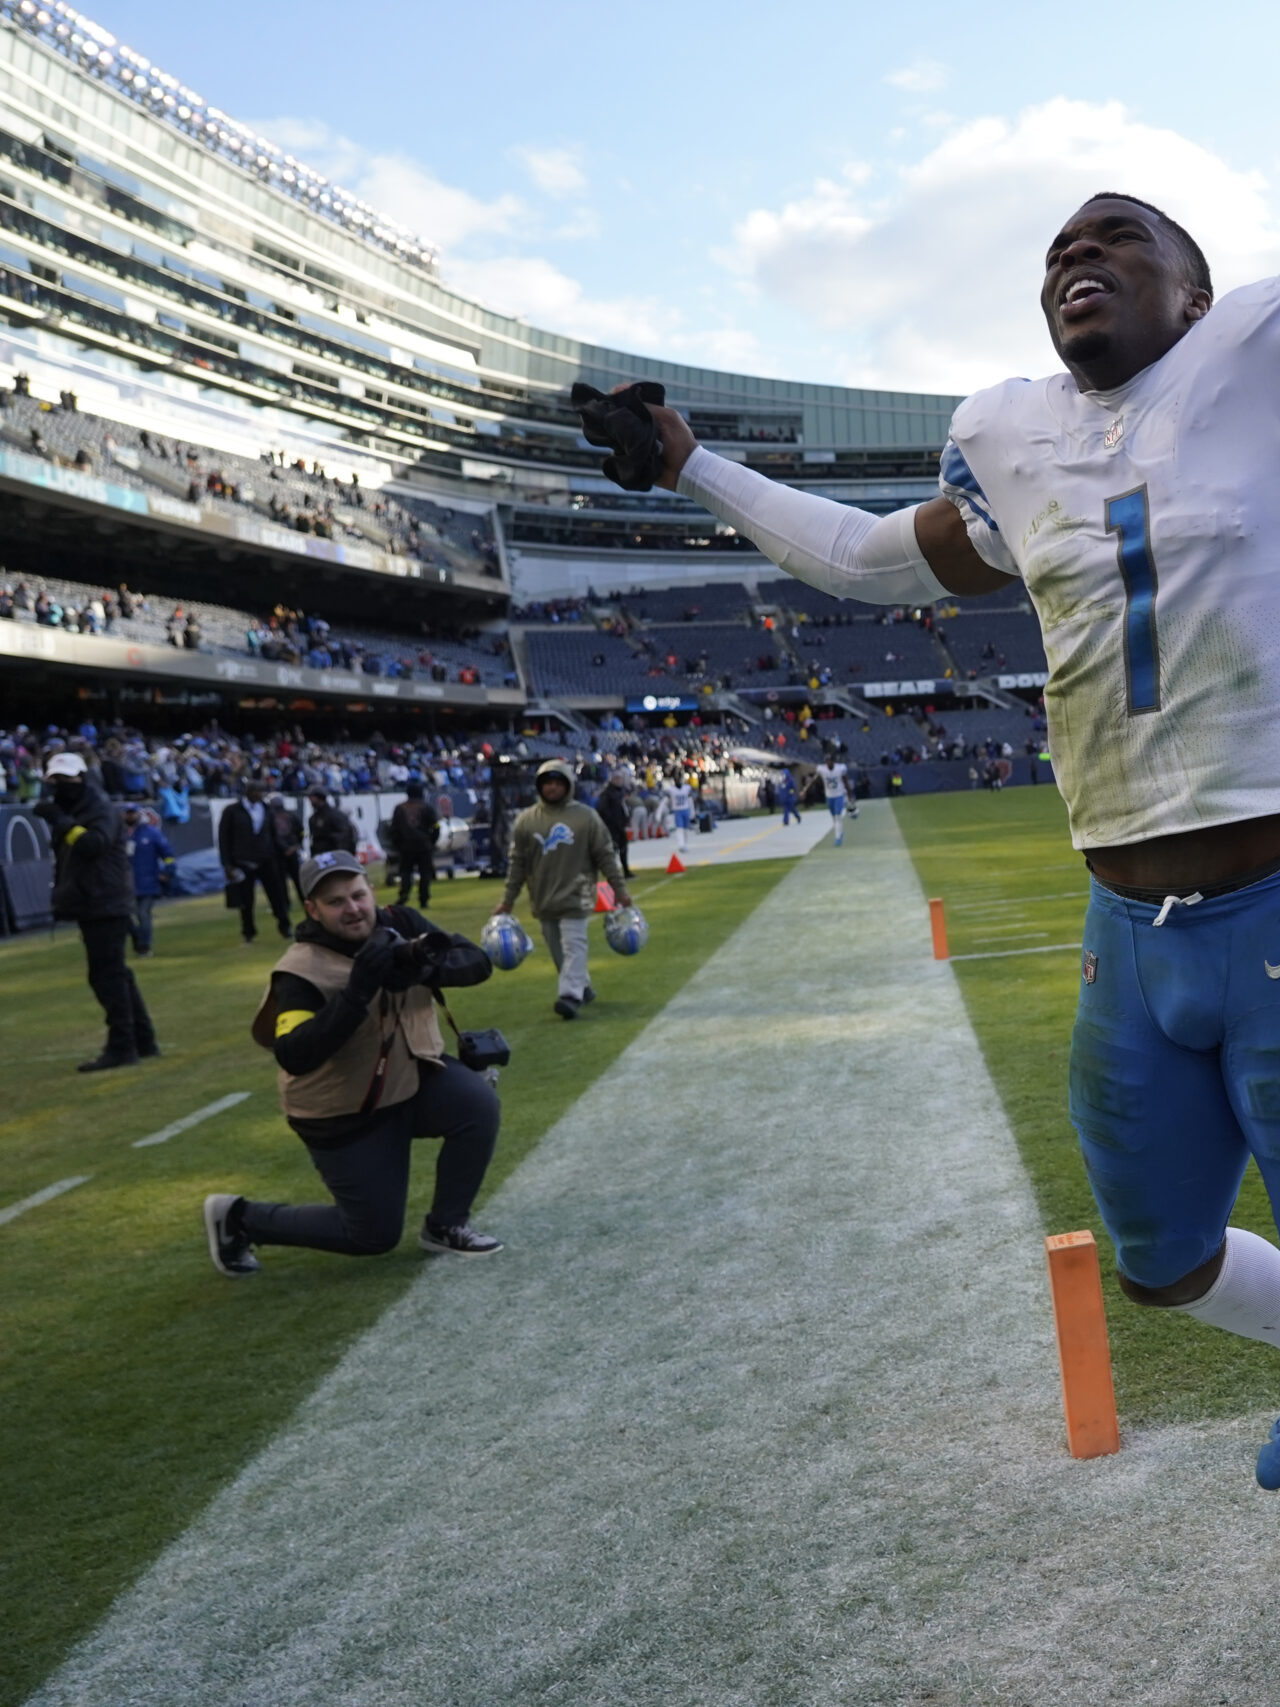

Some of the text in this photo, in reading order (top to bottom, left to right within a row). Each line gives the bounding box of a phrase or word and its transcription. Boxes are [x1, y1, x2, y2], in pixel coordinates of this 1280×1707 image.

[1106, 427, 1119, 442] NFL
[1104, 482, 1161, 718] 1
[999, 673, 1049, 688] DOW
[864, 681, 936, 697] BEAR
[657, 696, 681, 709] edge
